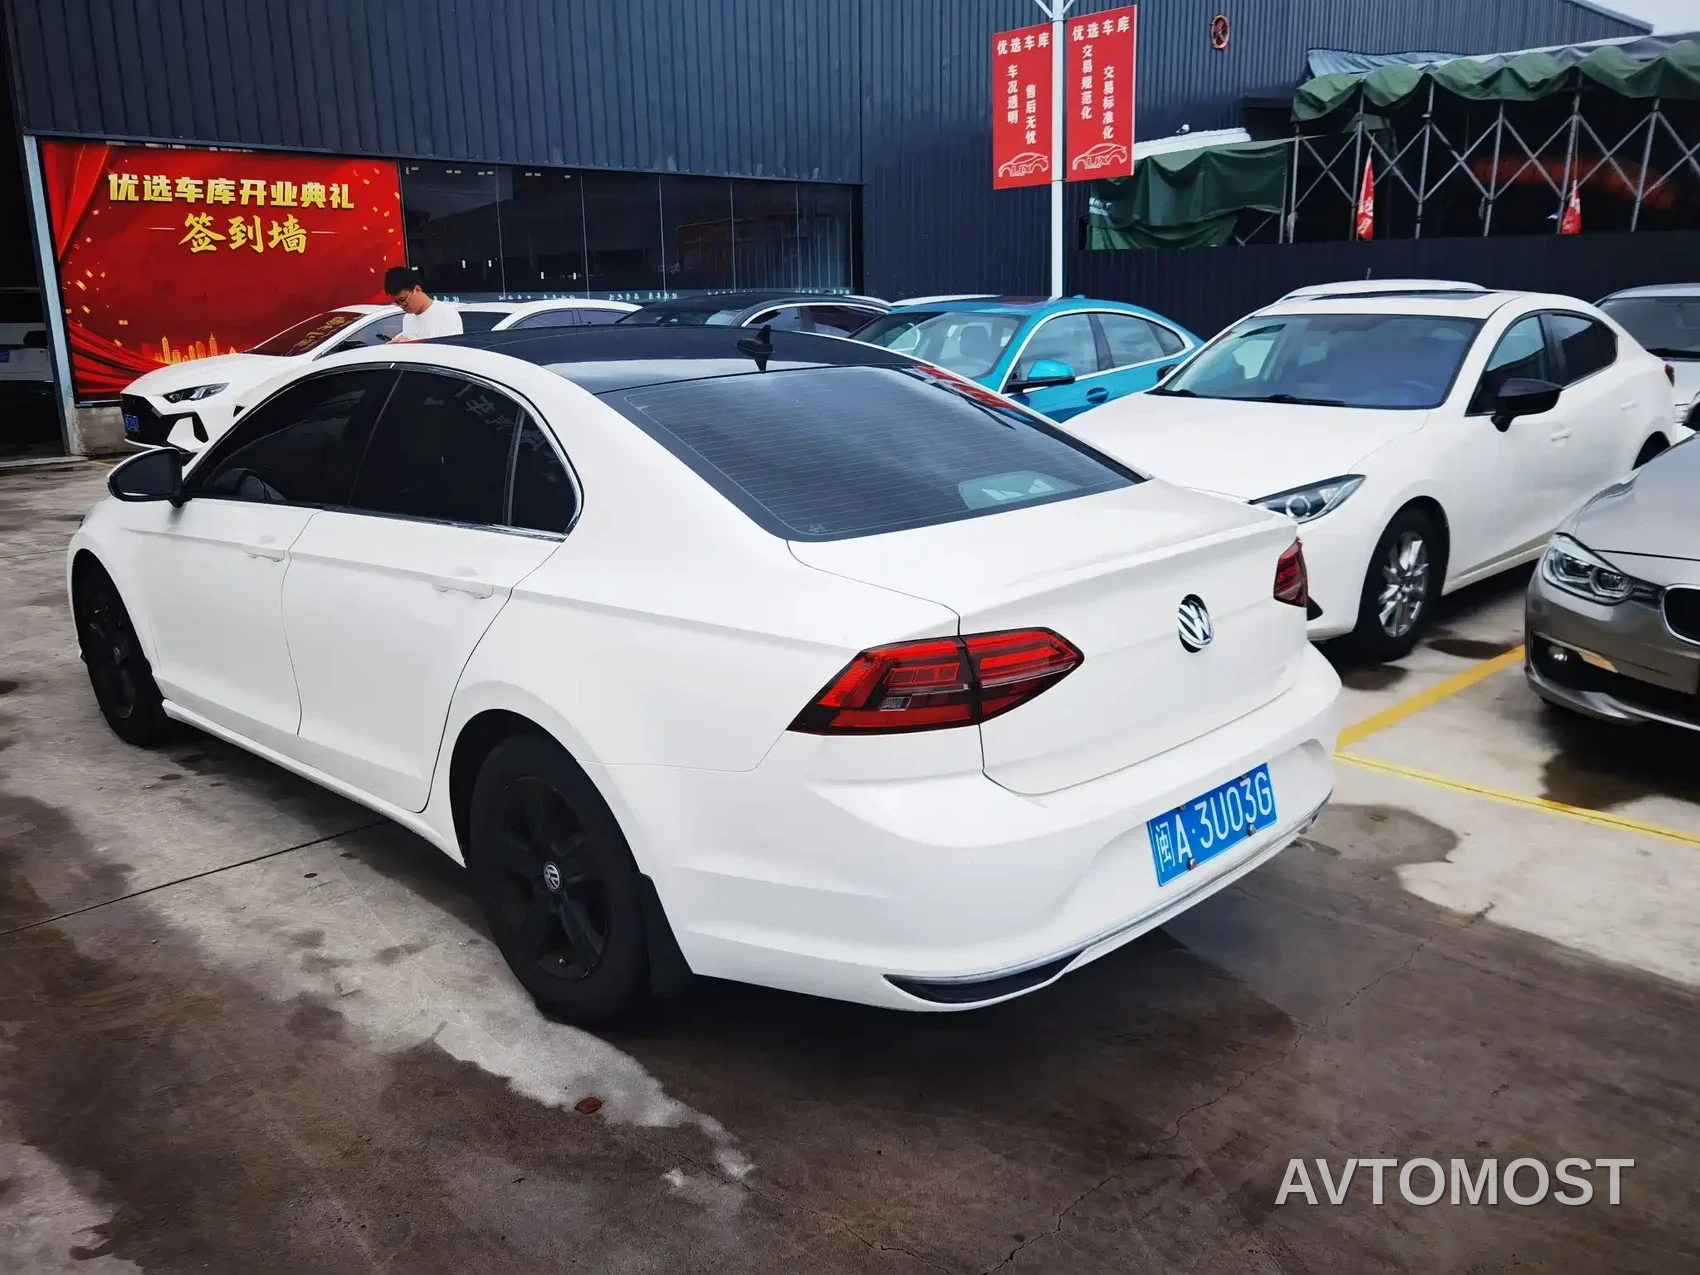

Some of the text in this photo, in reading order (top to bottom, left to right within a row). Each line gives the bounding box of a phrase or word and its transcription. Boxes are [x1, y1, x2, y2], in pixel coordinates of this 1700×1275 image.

[997, 32, 1050, 56] 优选车库
[1072, 16, 1130, 42] 优选车库
[1007, 64, 1019, 125] 车况透明
[1081, 44, 1093, 120] 交易规范化
[1102, 65, 1115, 140] 交易标准化
[1025, 84, 1037, 145] 售后无忧
[108, 173, 355, 210] 优选车库开业典礼
[179, 212, 307, 254] 签到墙
